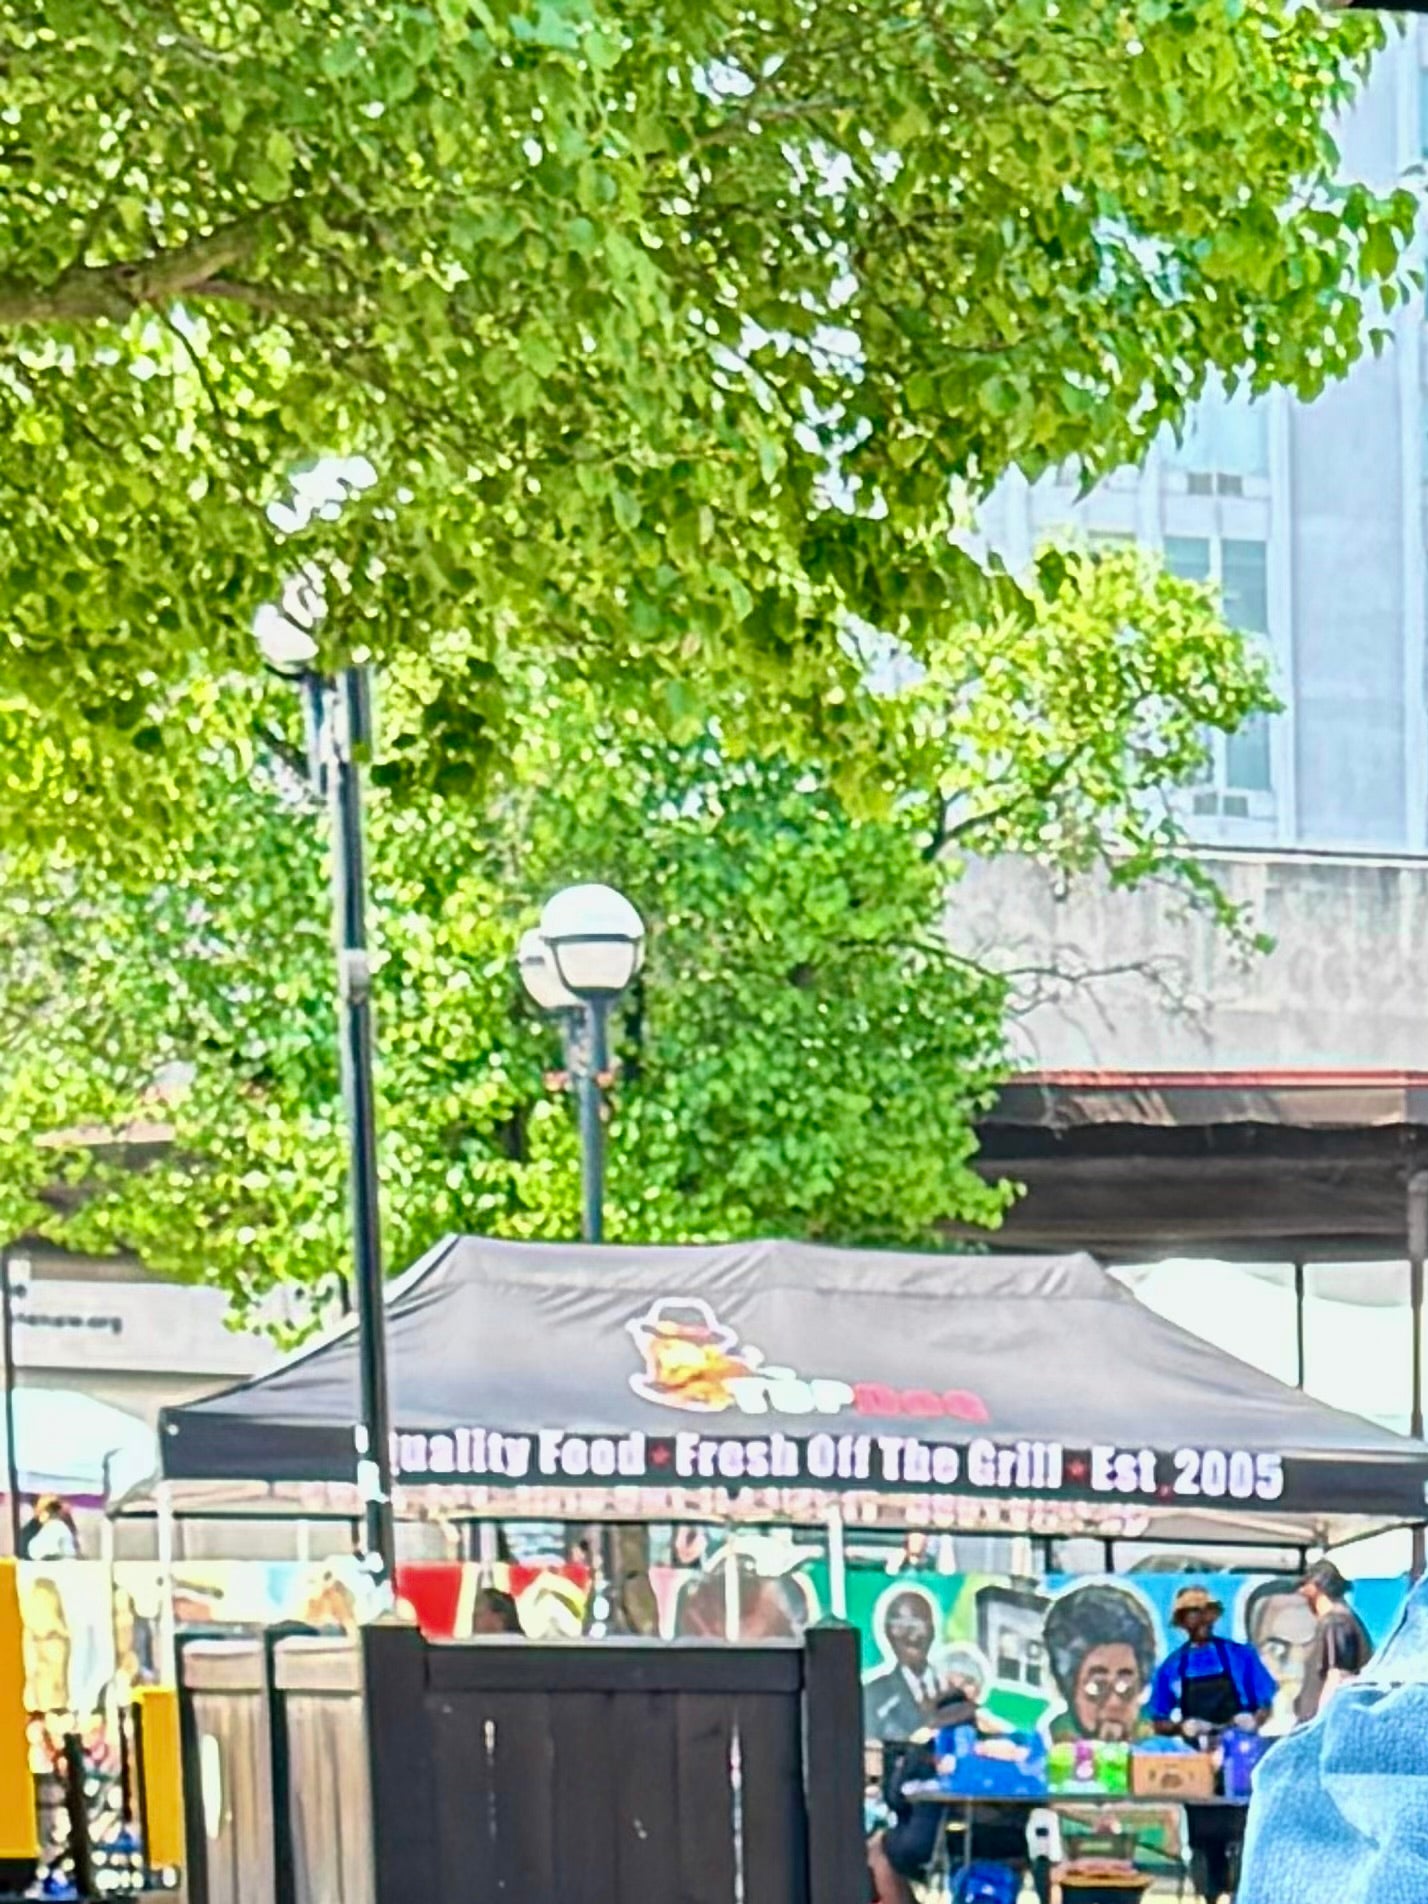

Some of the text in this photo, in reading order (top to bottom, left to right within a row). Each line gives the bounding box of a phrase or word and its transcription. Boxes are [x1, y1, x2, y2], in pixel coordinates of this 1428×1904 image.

[538, 1429, 646, 1476] Food
[675, 1431, 799, 1478] Fresh
[806, 1433, 871, 1479] Off
[874, 1435, 959, 1484] The
[967, 1438, 1063, 1489] Grill
[1173, 1448, 1284, 1500] 2005
